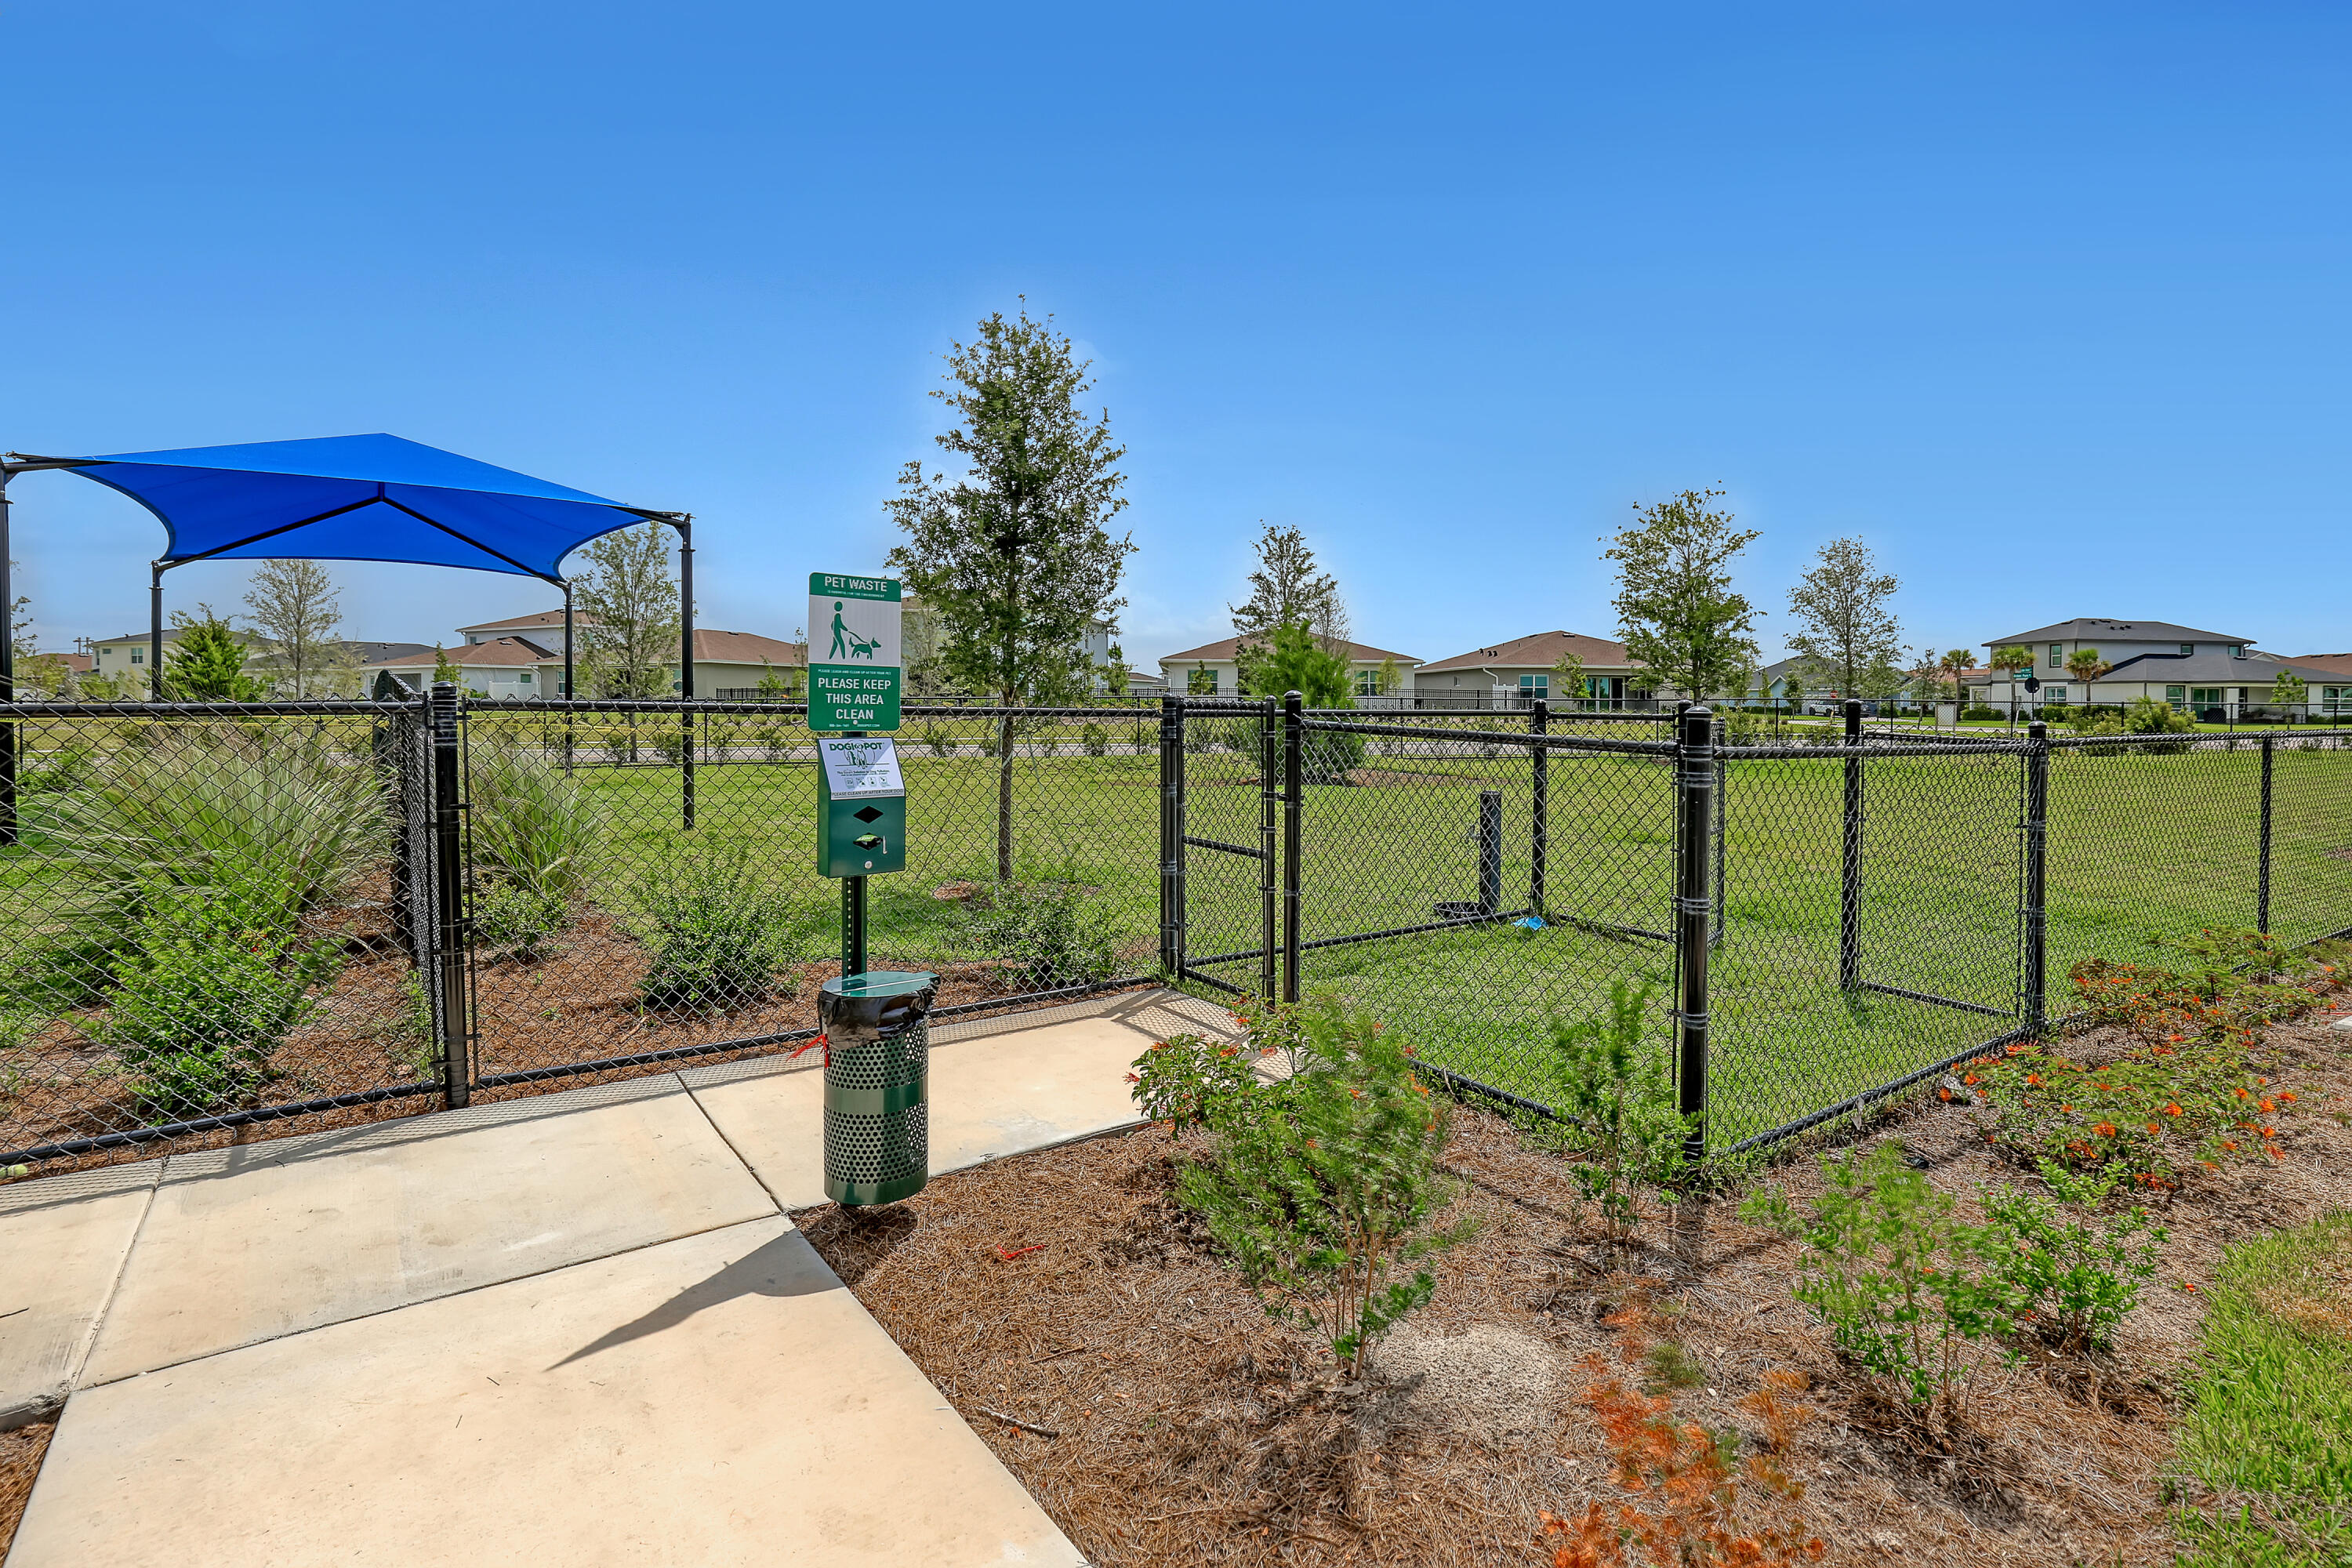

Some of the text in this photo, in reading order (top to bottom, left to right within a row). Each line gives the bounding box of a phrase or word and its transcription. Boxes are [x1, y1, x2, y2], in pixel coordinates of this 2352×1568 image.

[825, 575, 887, 592] PET WASTE
[818, 677, 891, 690] PLEASE KEEP
[826, 693, 884, 705] THIS AREA
[836, 709, 873, 720] CLEAN
